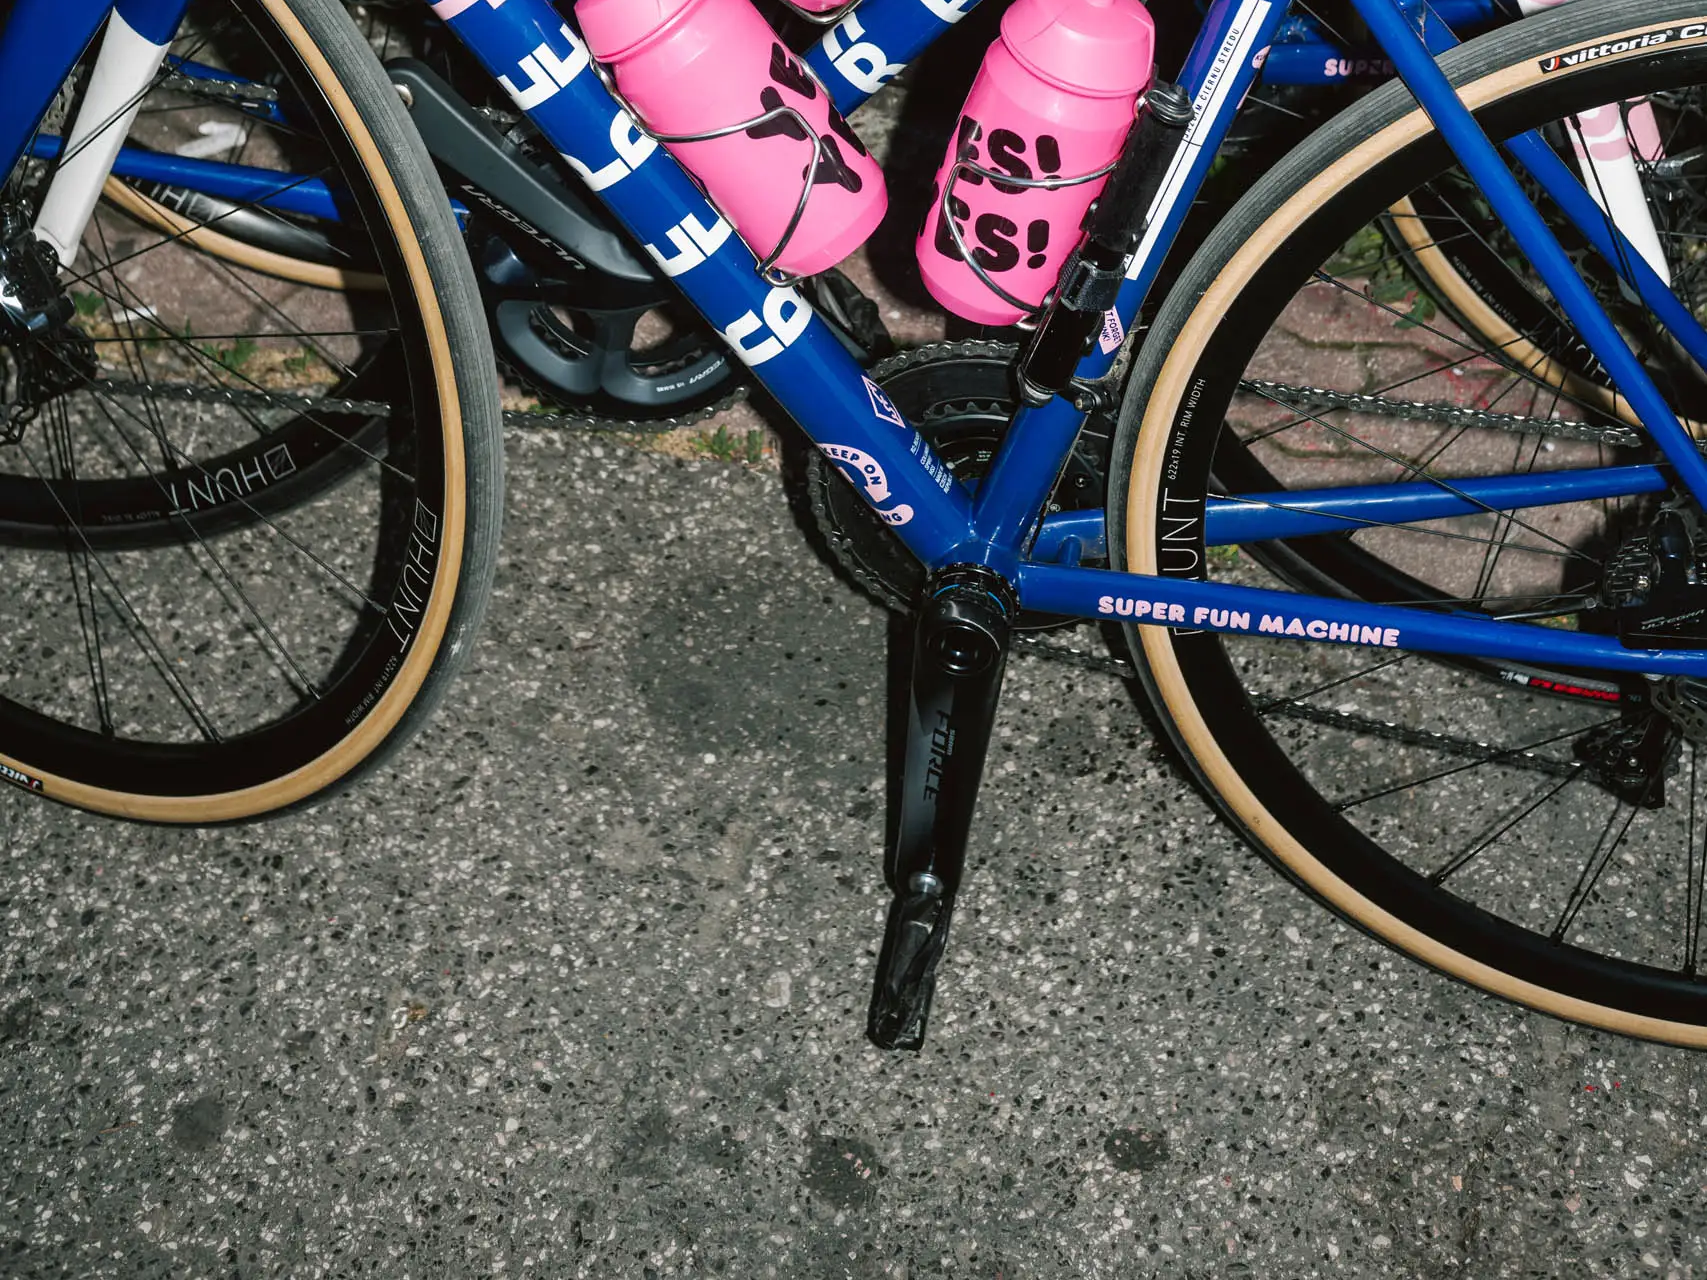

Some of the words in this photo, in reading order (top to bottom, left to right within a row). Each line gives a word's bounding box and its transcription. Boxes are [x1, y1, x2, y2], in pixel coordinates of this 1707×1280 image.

[1218, 28, 1240, 64] STREDU
[460, 183, 587, 271] ULTEGRA
[1187, 378, 1207, 412] WIDTH
[1175, 431, 1186, 448] INT
[1180, 411, 1192, 431] RIM
[864, 464, 882, 486] ON
[1167, 447, 1181, 480] 622x19
[168, 455, 266, 517] HUNT
[1161, 486, 1201, 583] UNT
[386, 532, 435, 654] HUNT
[1098, 595, 1185, 622] SUPER
[1194, 606, 1250, 631] FUN
[1258, 614, 1401, 648] MACHINE
[923, 709, 951, 801] FORCE
